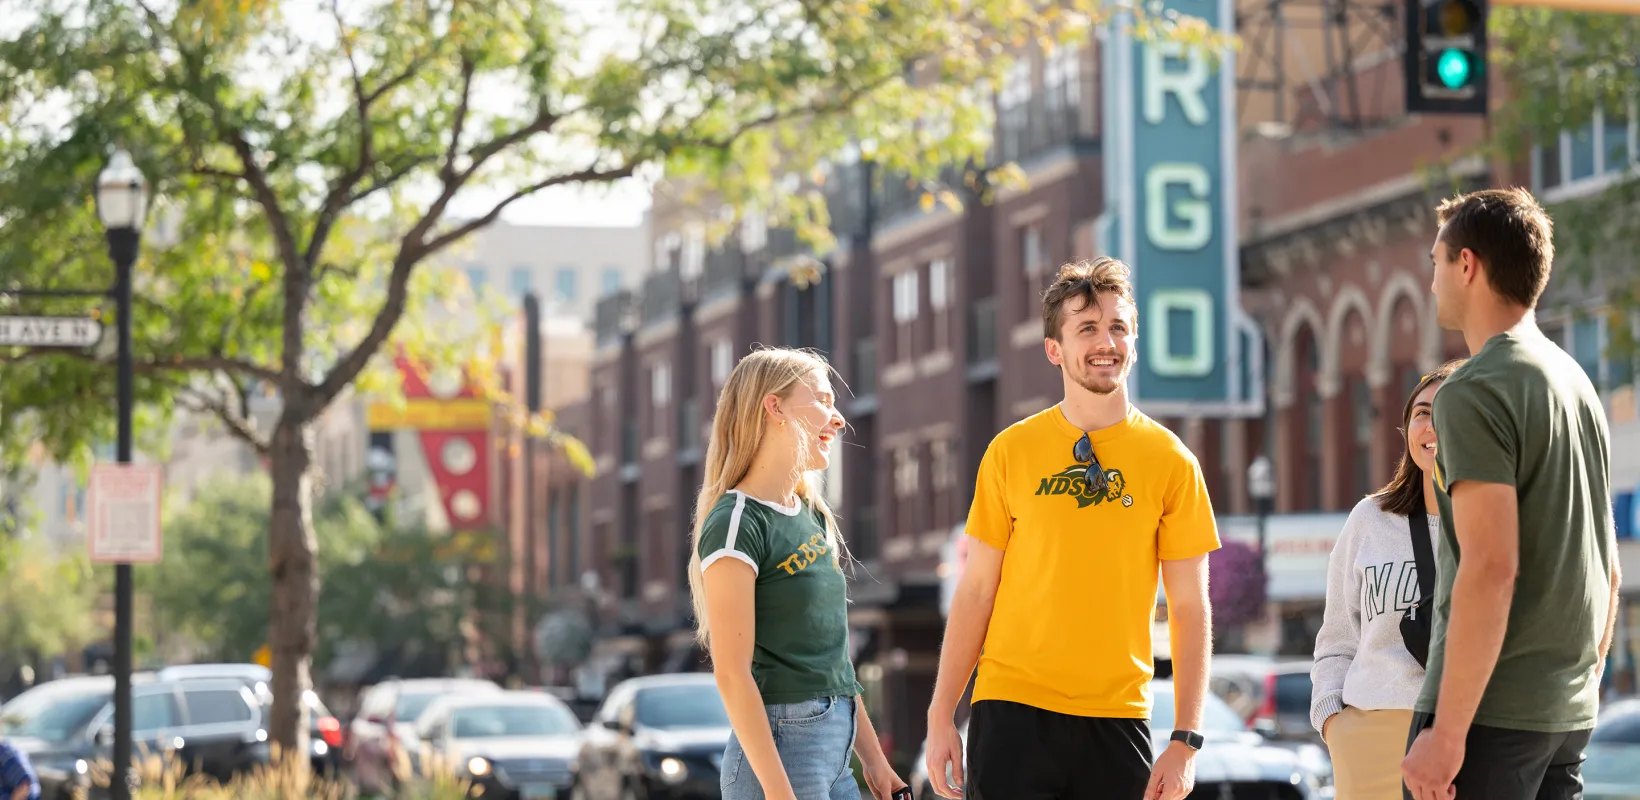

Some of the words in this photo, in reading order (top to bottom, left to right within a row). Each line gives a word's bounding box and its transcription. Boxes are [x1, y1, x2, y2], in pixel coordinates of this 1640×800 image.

[19, 319, 62, 342] AVE
[71, 319, 89, 342] N
[776, 532, 840, 575] NDS
